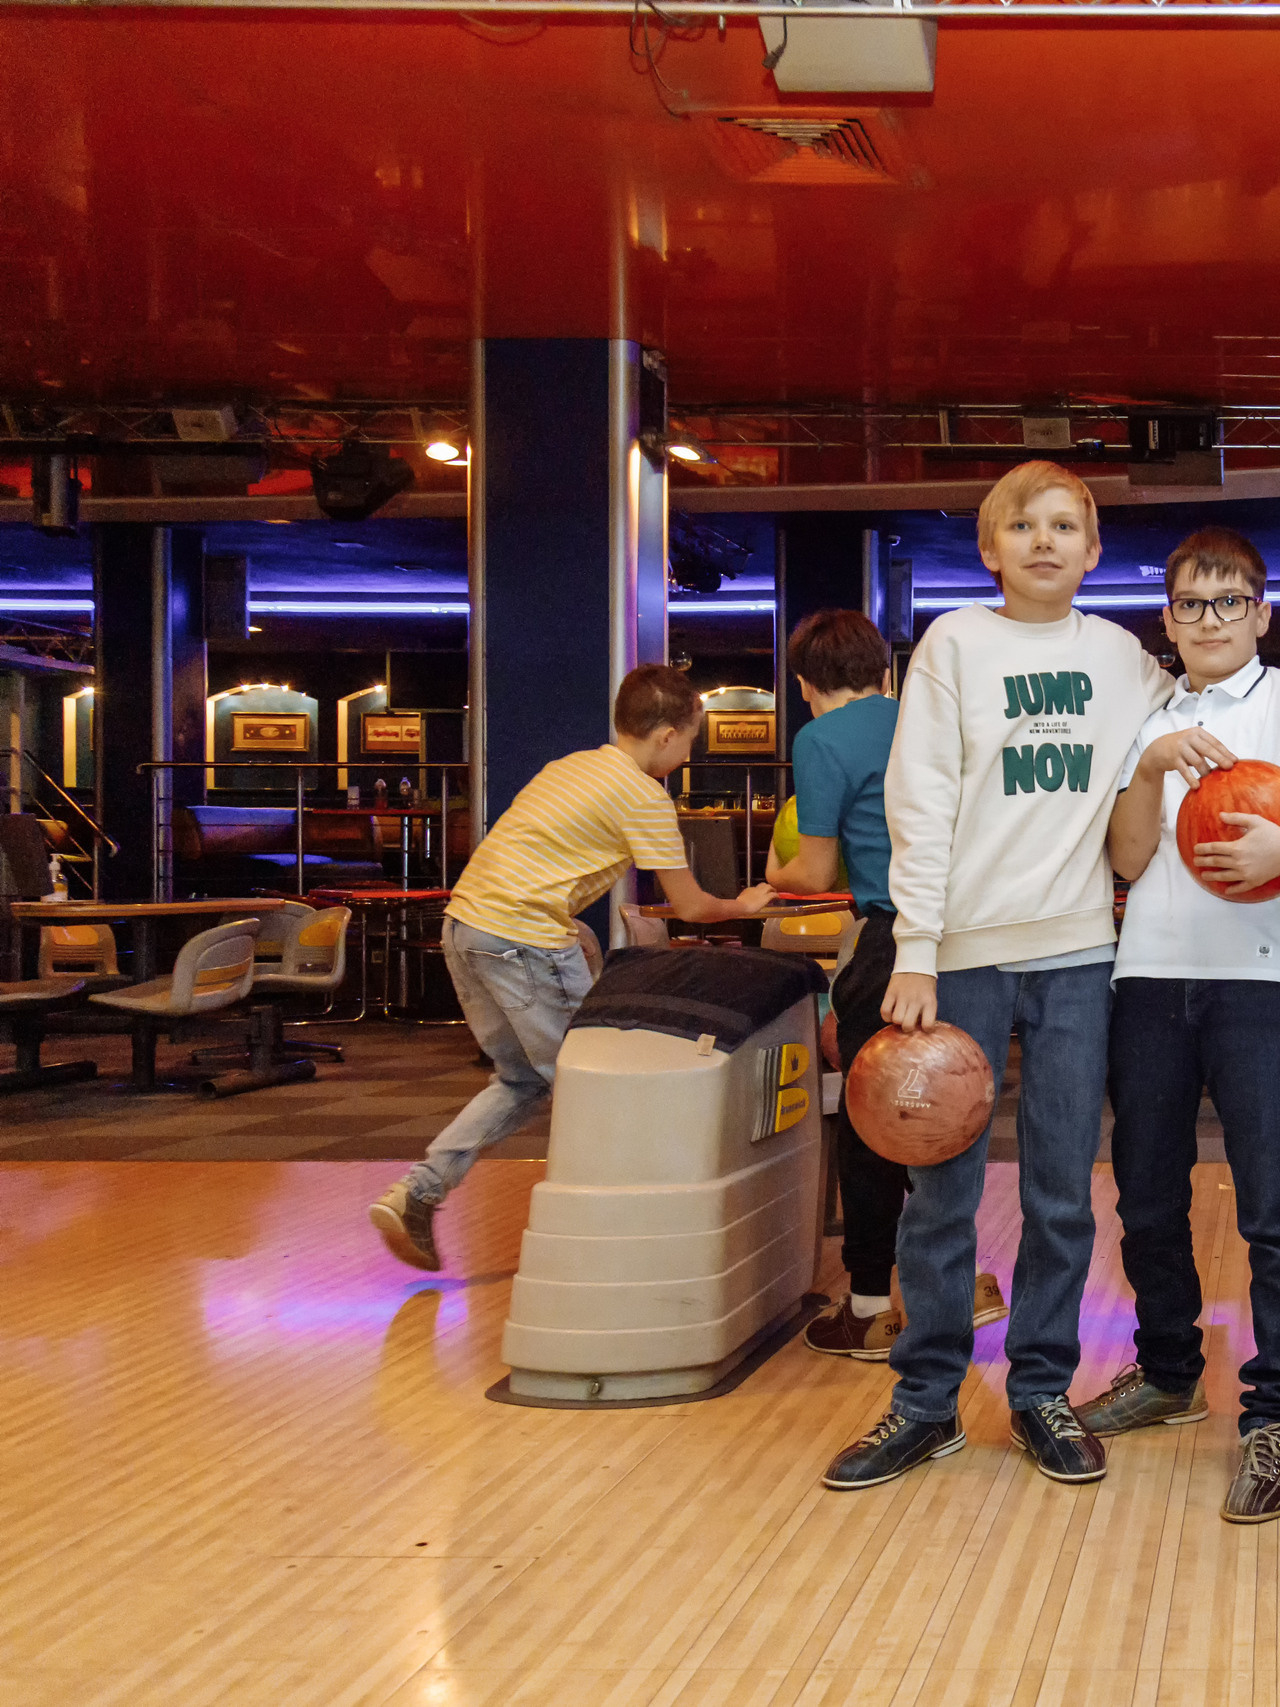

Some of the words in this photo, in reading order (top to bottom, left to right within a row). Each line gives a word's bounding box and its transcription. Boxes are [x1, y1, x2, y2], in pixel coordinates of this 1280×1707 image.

[1003, 671, 1093, 719] JUMP
[1003, 742, 1094, 796] NOW
[983, 1285, 1000, 1298] 39
[884, 1322, 901, 1337] 39
